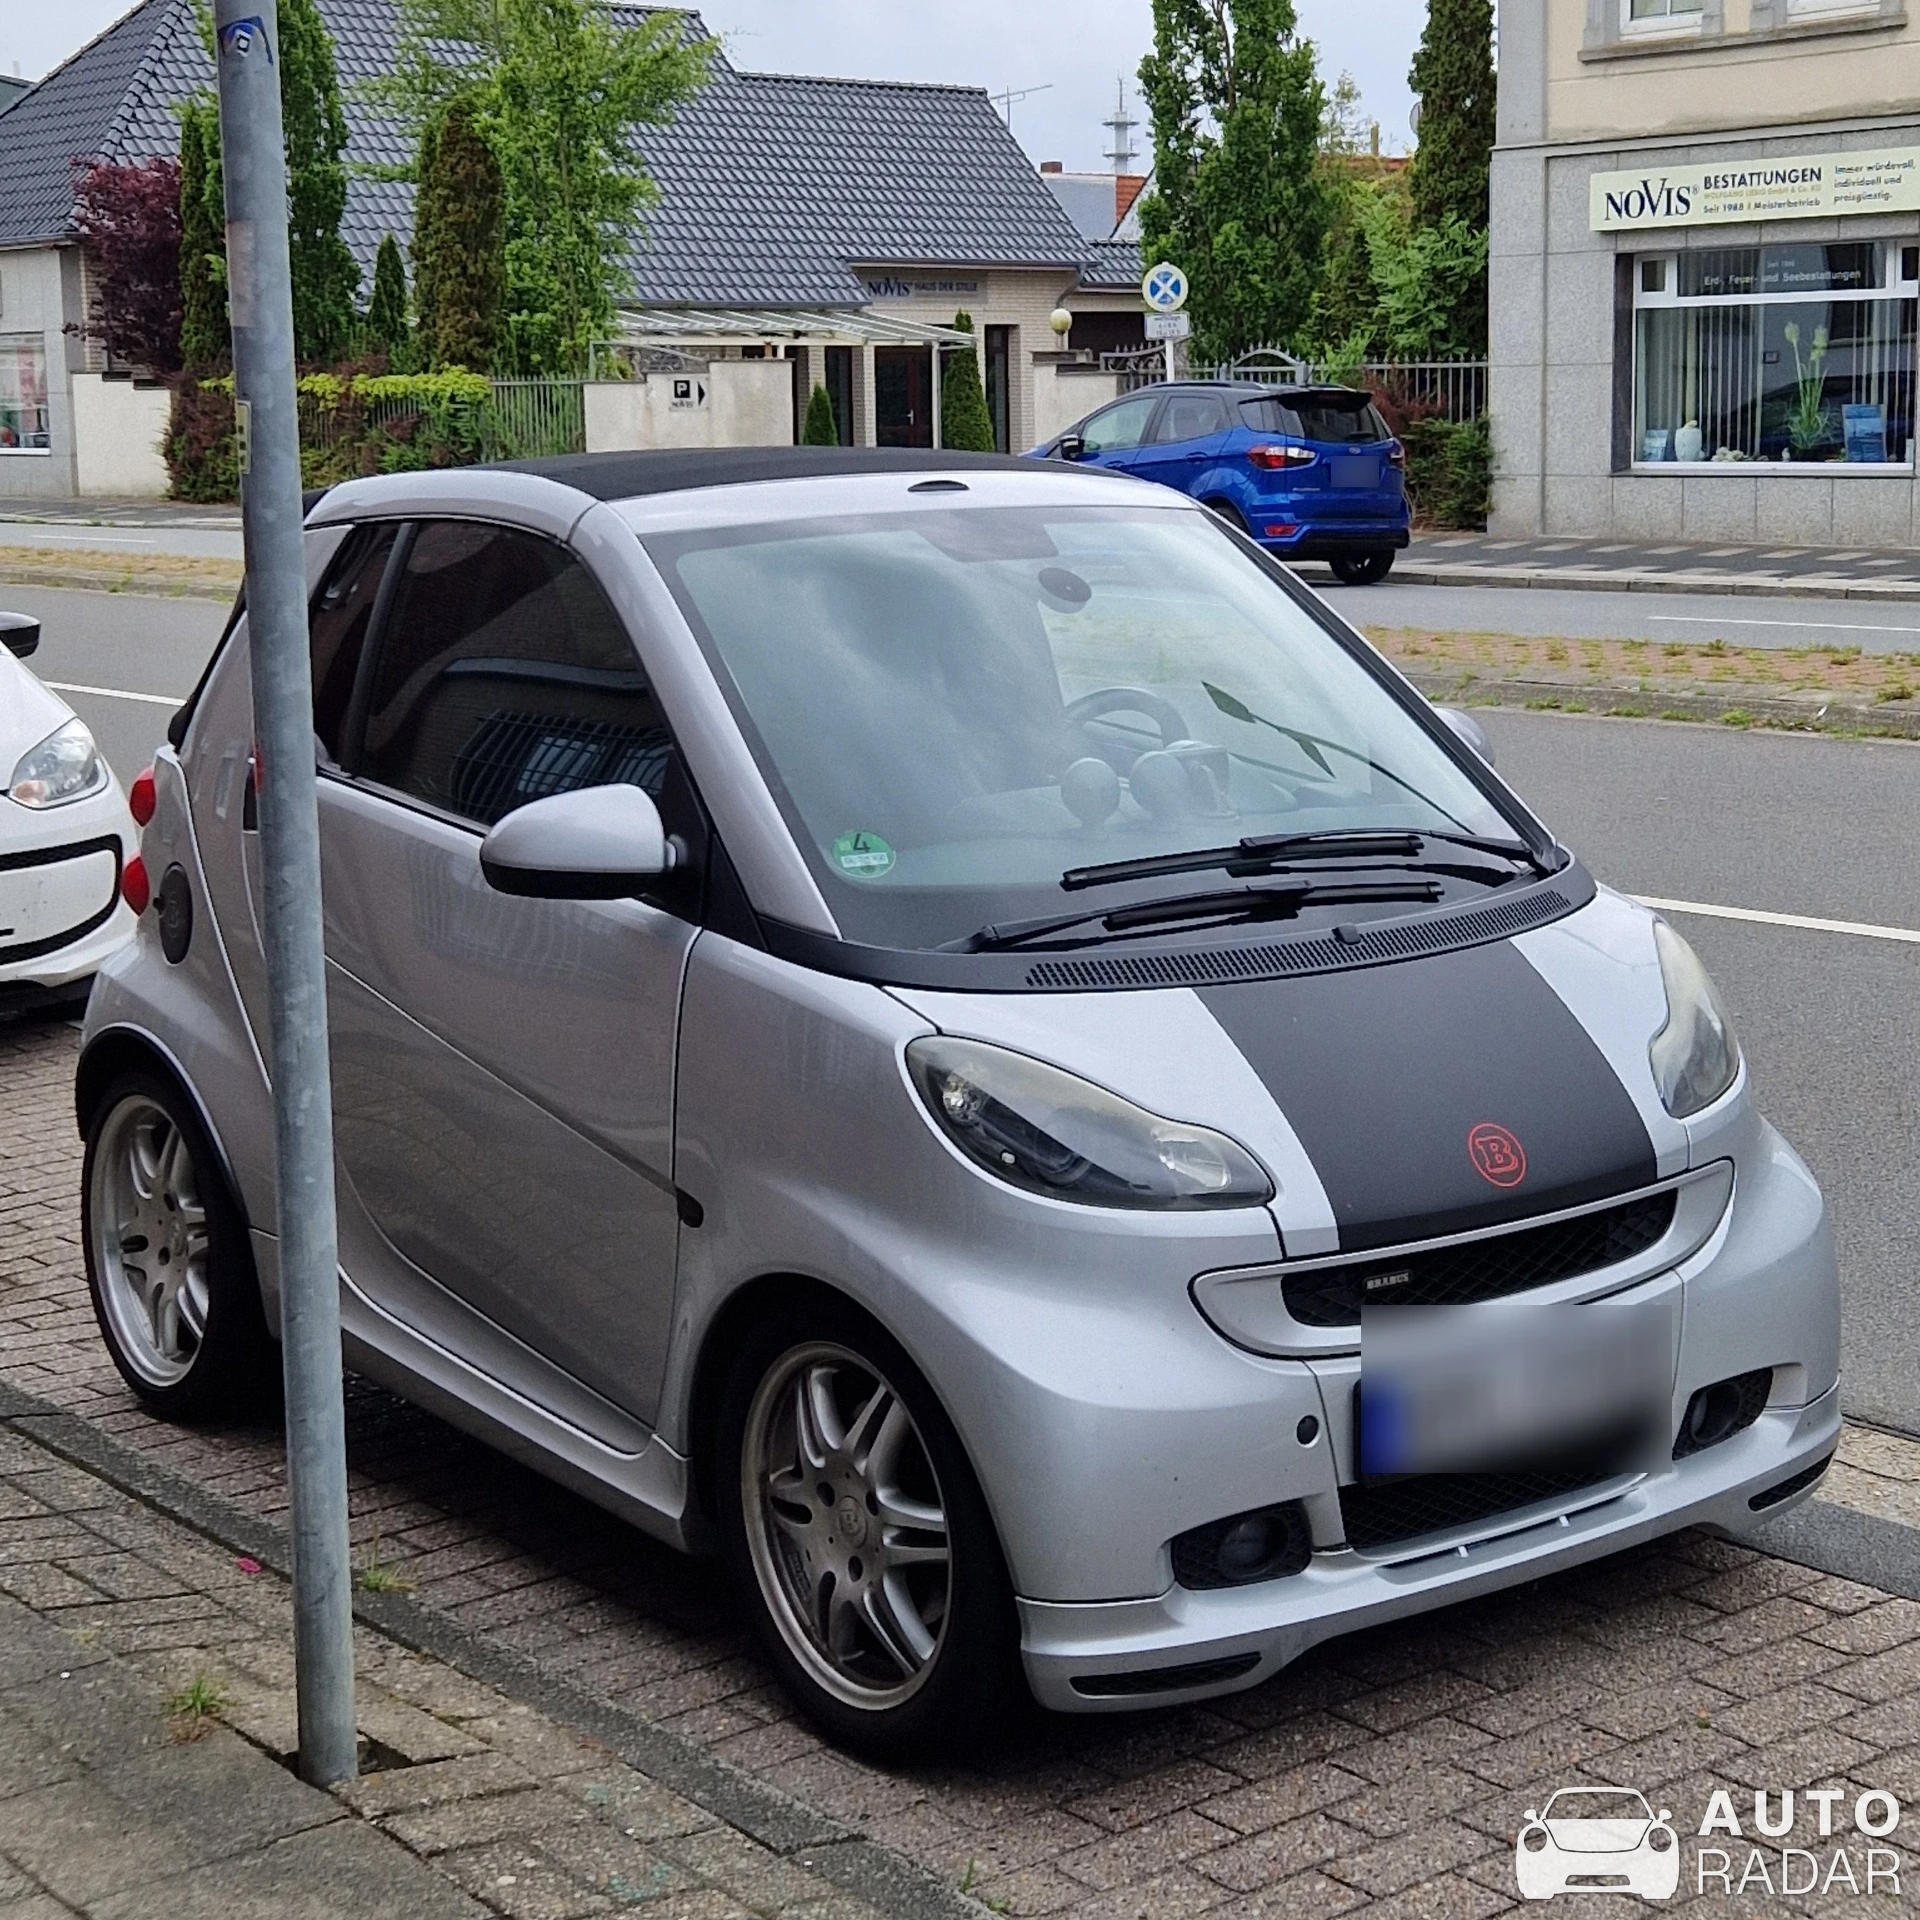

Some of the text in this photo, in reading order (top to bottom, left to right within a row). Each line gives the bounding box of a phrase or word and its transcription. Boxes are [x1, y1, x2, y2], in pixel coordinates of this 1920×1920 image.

[1703, 166, 1822, 190] BESTATTUNGEN
[1703, 204, 1719, 213] Seit
[1753, 196, 1821, 210] Meisterbetrieb
[1783, 270, 1861, 282] Seebestattungen
[675, 381, 689, 397] P
[853, 833, 871, 853] 4
[1475, 1135, 1518, 1174] B
[1366, 1272, 1409, 1290] BRABUS
